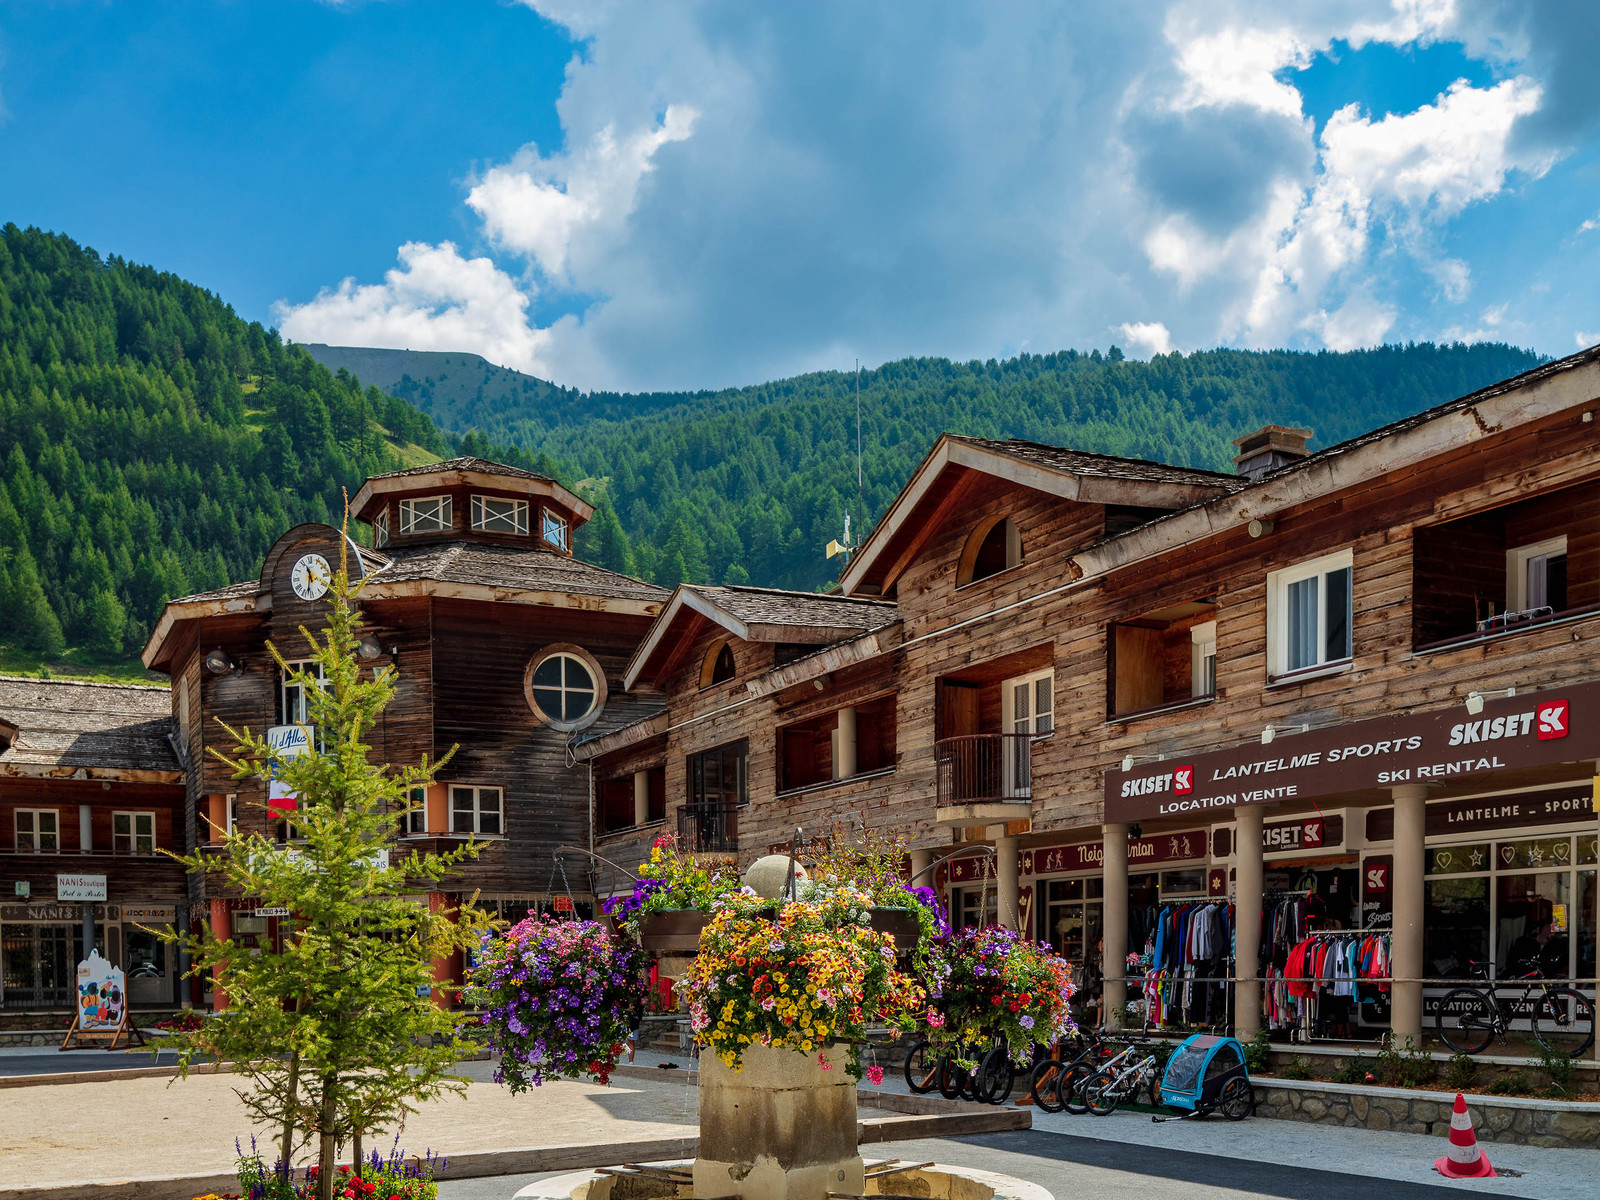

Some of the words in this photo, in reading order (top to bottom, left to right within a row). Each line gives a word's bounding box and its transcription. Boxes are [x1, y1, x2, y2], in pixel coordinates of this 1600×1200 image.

[1448, 711, 1536, 746] SKISET
[1212, 752, 1322, 781] LANTELME
[1326, 735, 1423, 763] SPORTS
[1377, 769, 1411, 784] SKI
[1417, 756, 1506, 778] RENTAL
[1120, 773, 1173, 798] SKISET
[1159, 794, 1237, 814] LOCATION
[1241, 785, 1298, 802] VENTE
[1448, 804, 1520, 823] LANTELME
[1545, 797, 1594, 813] SPORT
[1077, 844, 1105, 867] Neig
[59, 877, 83, 887] NANIS
[28, 906, 73, 920] NANIS
[1426, 1001, 1482, 1012] LOATION
[1509, 1002, 1550, 1013] VENE
